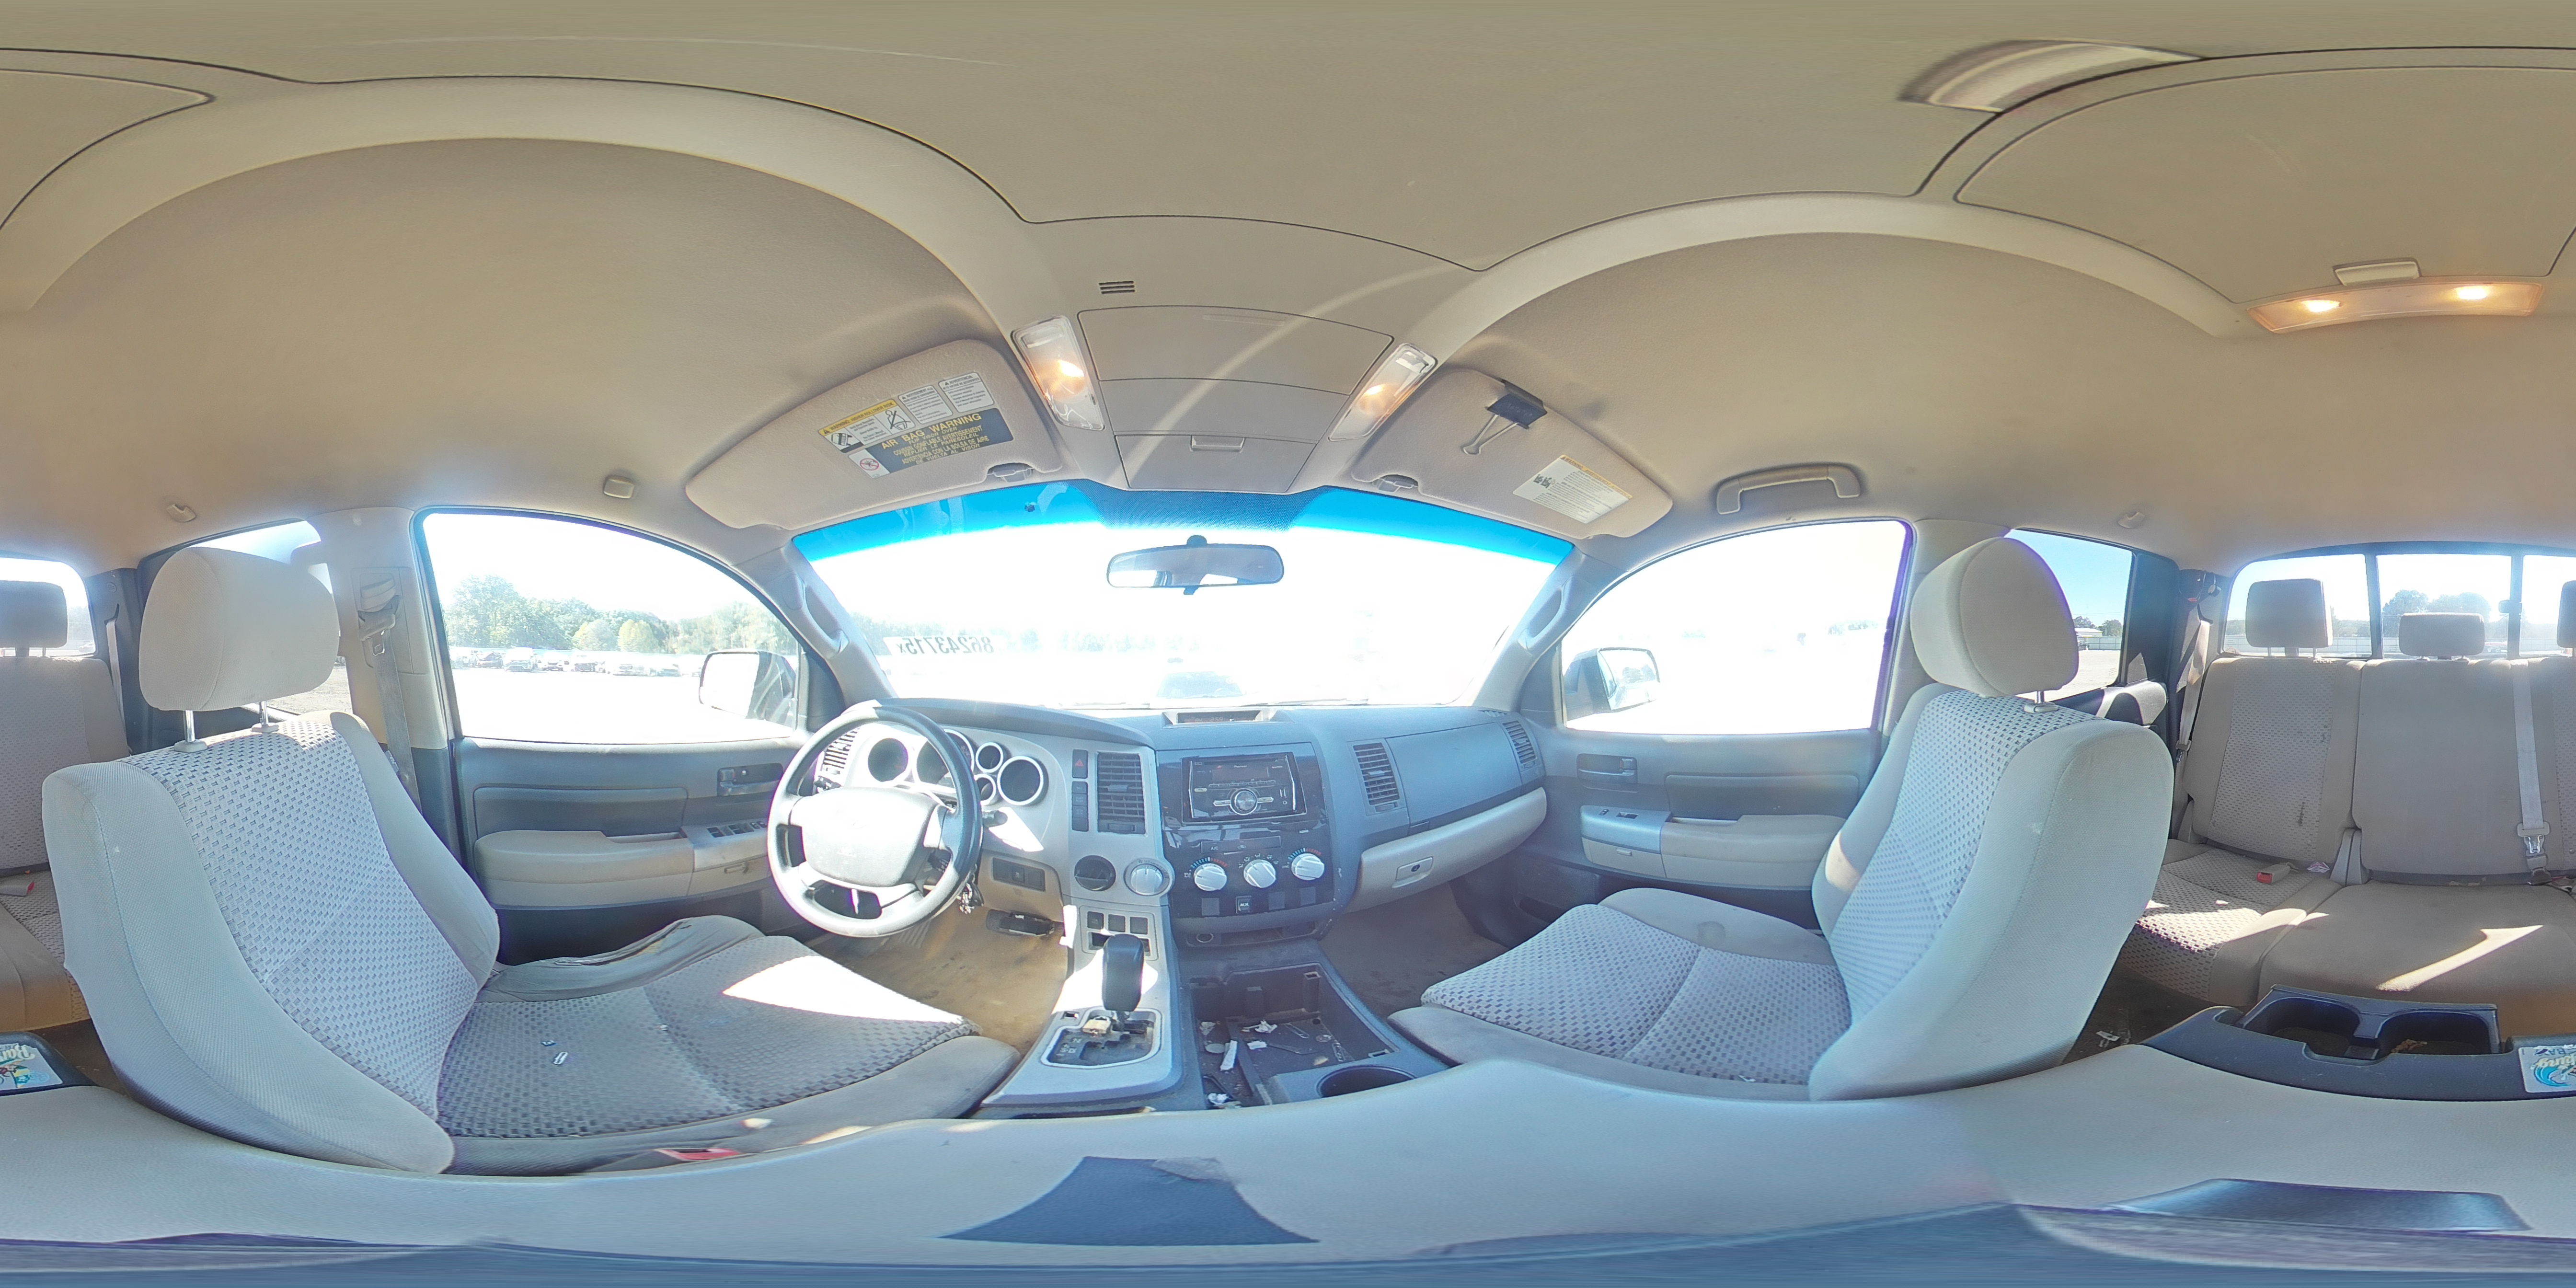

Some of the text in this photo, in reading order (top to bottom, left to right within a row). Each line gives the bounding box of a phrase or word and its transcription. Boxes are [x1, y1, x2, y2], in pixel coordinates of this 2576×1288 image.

[882, 414, 982, 449] AIR BAG WARNING
[913, 437, 943, 449] GONFLABLE
[942, 425, 982, 440] AVERTISSEMENT
[941, 433, 979, 446] PARESOLEIL
[950, 441, 968, 449] BOLSA
[926, 452, 948, 461] VUELTA
